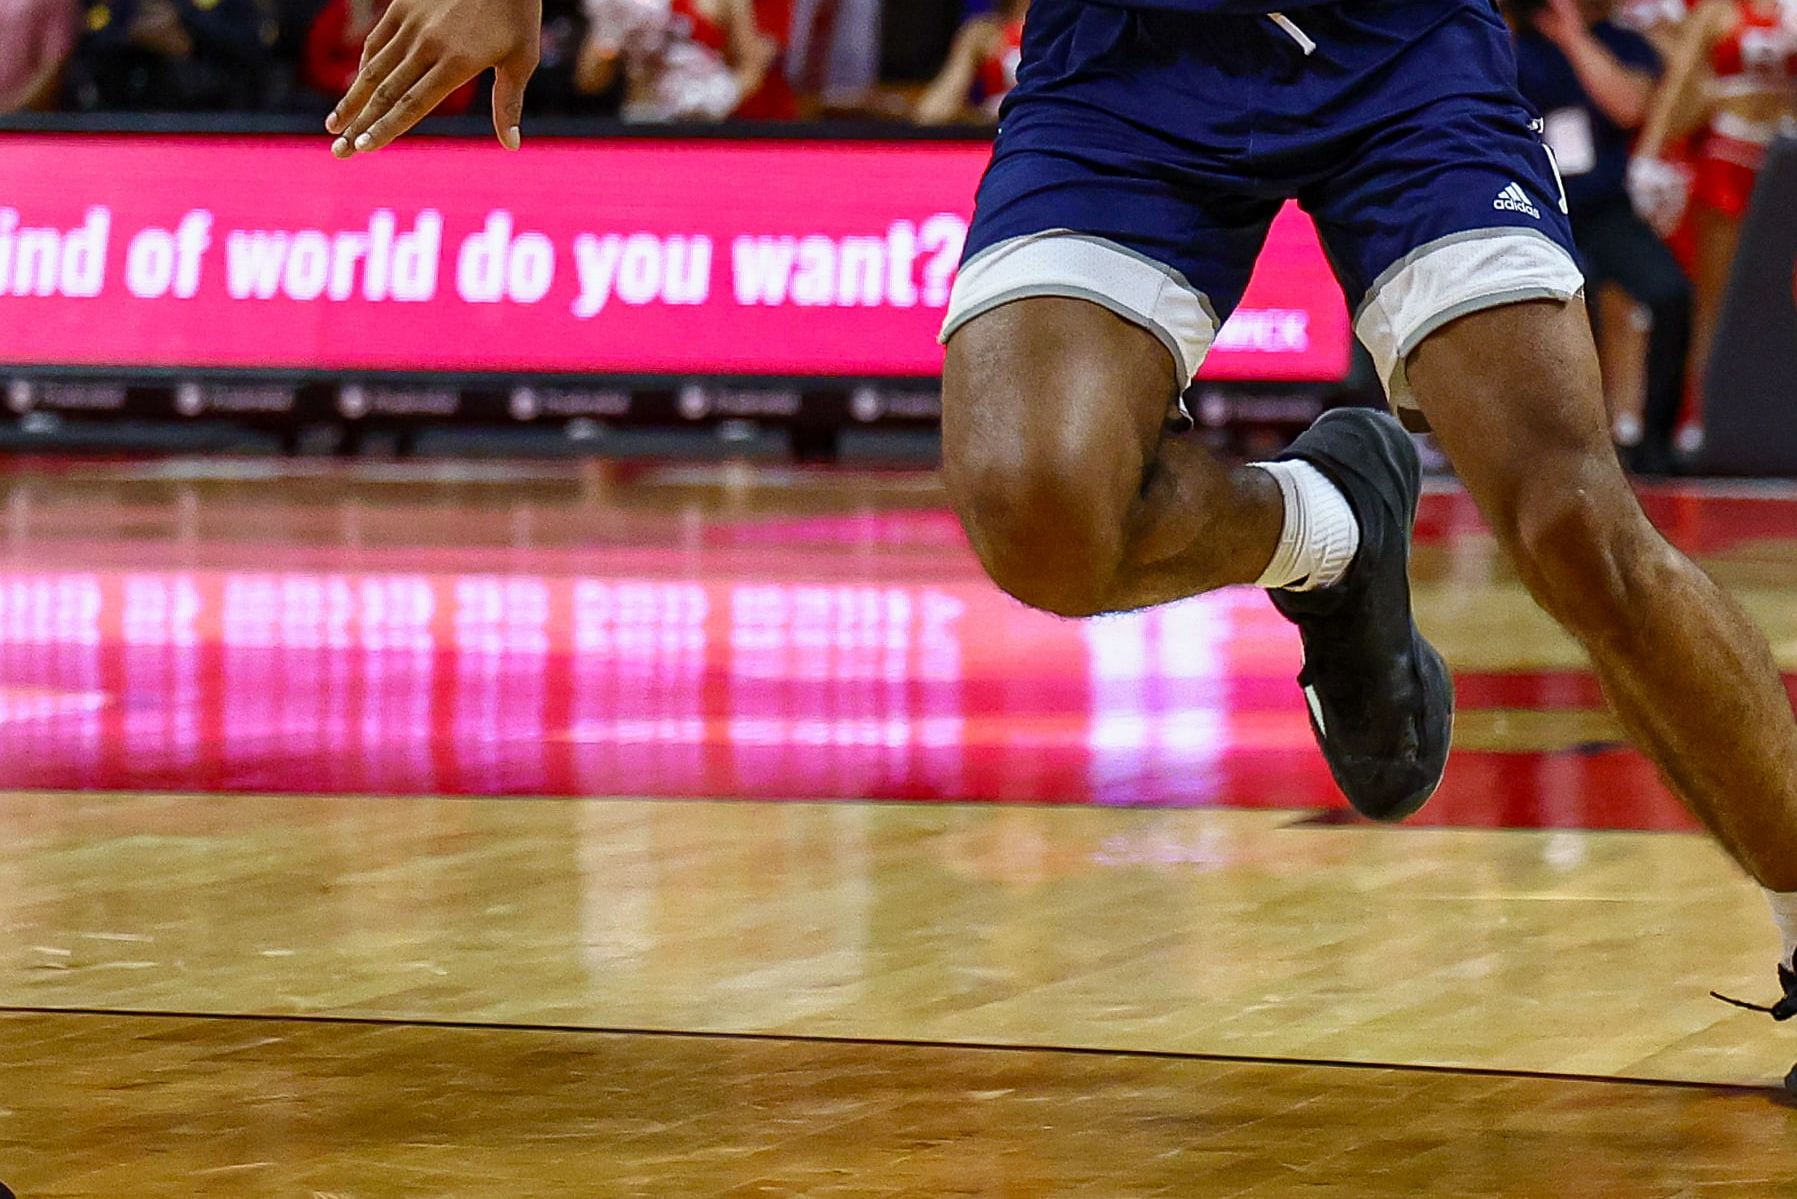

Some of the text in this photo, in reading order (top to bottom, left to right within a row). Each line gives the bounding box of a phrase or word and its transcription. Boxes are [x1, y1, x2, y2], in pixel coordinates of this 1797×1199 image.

[1493, 199, 1541, 219] adidas
[125, 209, 214, 299] of
[226, 208, 443, 302] world
[456, 209, 556, 303] do
[571, 233, 713, 319] you
[732, 213, 968, 307] want?
